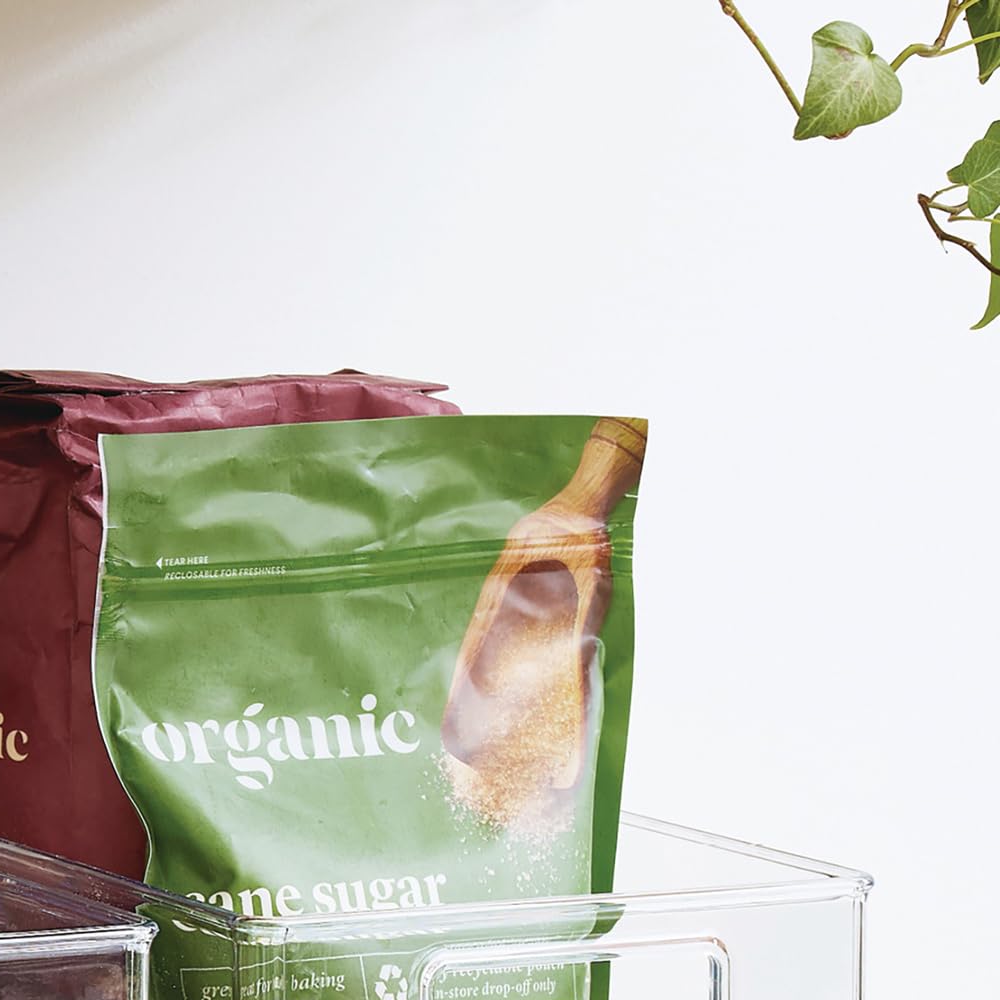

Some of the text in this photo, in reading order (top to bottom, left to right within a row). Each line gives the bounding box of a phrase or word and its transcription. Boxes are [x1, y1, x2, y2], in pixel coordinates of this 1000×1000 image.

[164, 556, 209, 567] TEAR HERE
[164, 565, 287, 581] RECLOSABLE FOR FRESHNESS
[142, 693, 421, 790] organic
[312, 873, 447, 914] sugar
[482, 978, 532, 999] drop-off
[533, 977, 557, 995] only
